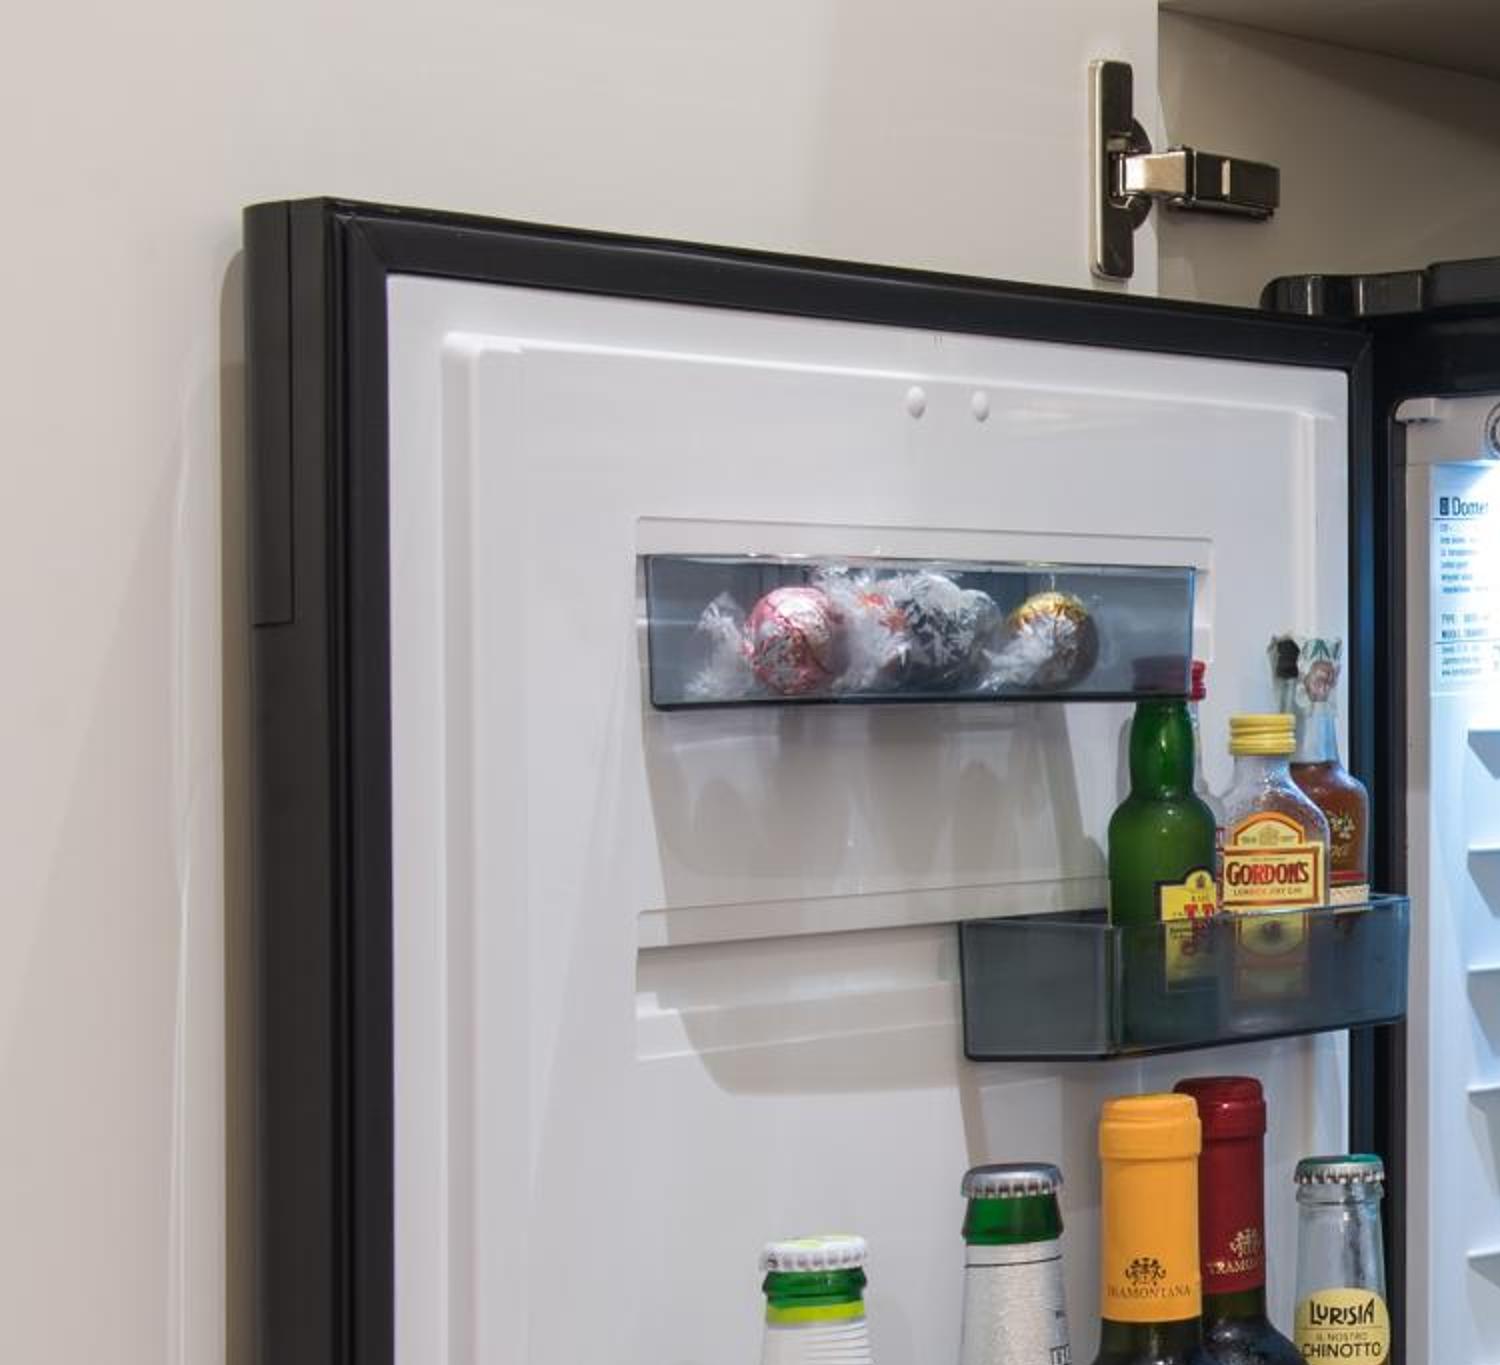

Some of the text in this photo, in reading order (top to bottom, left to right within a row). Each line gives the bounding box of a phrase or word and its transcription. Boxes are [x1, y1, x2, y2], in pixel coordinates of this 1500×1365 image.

[1226, 859, 1309, 887] GORDON'S
[1107, 1283, 1192, 1299] TRAMONTANA
[1310, 1298, 1376, 1326] LURISIA
[1303, 1341, 1382, 1359] CHINOTTO
